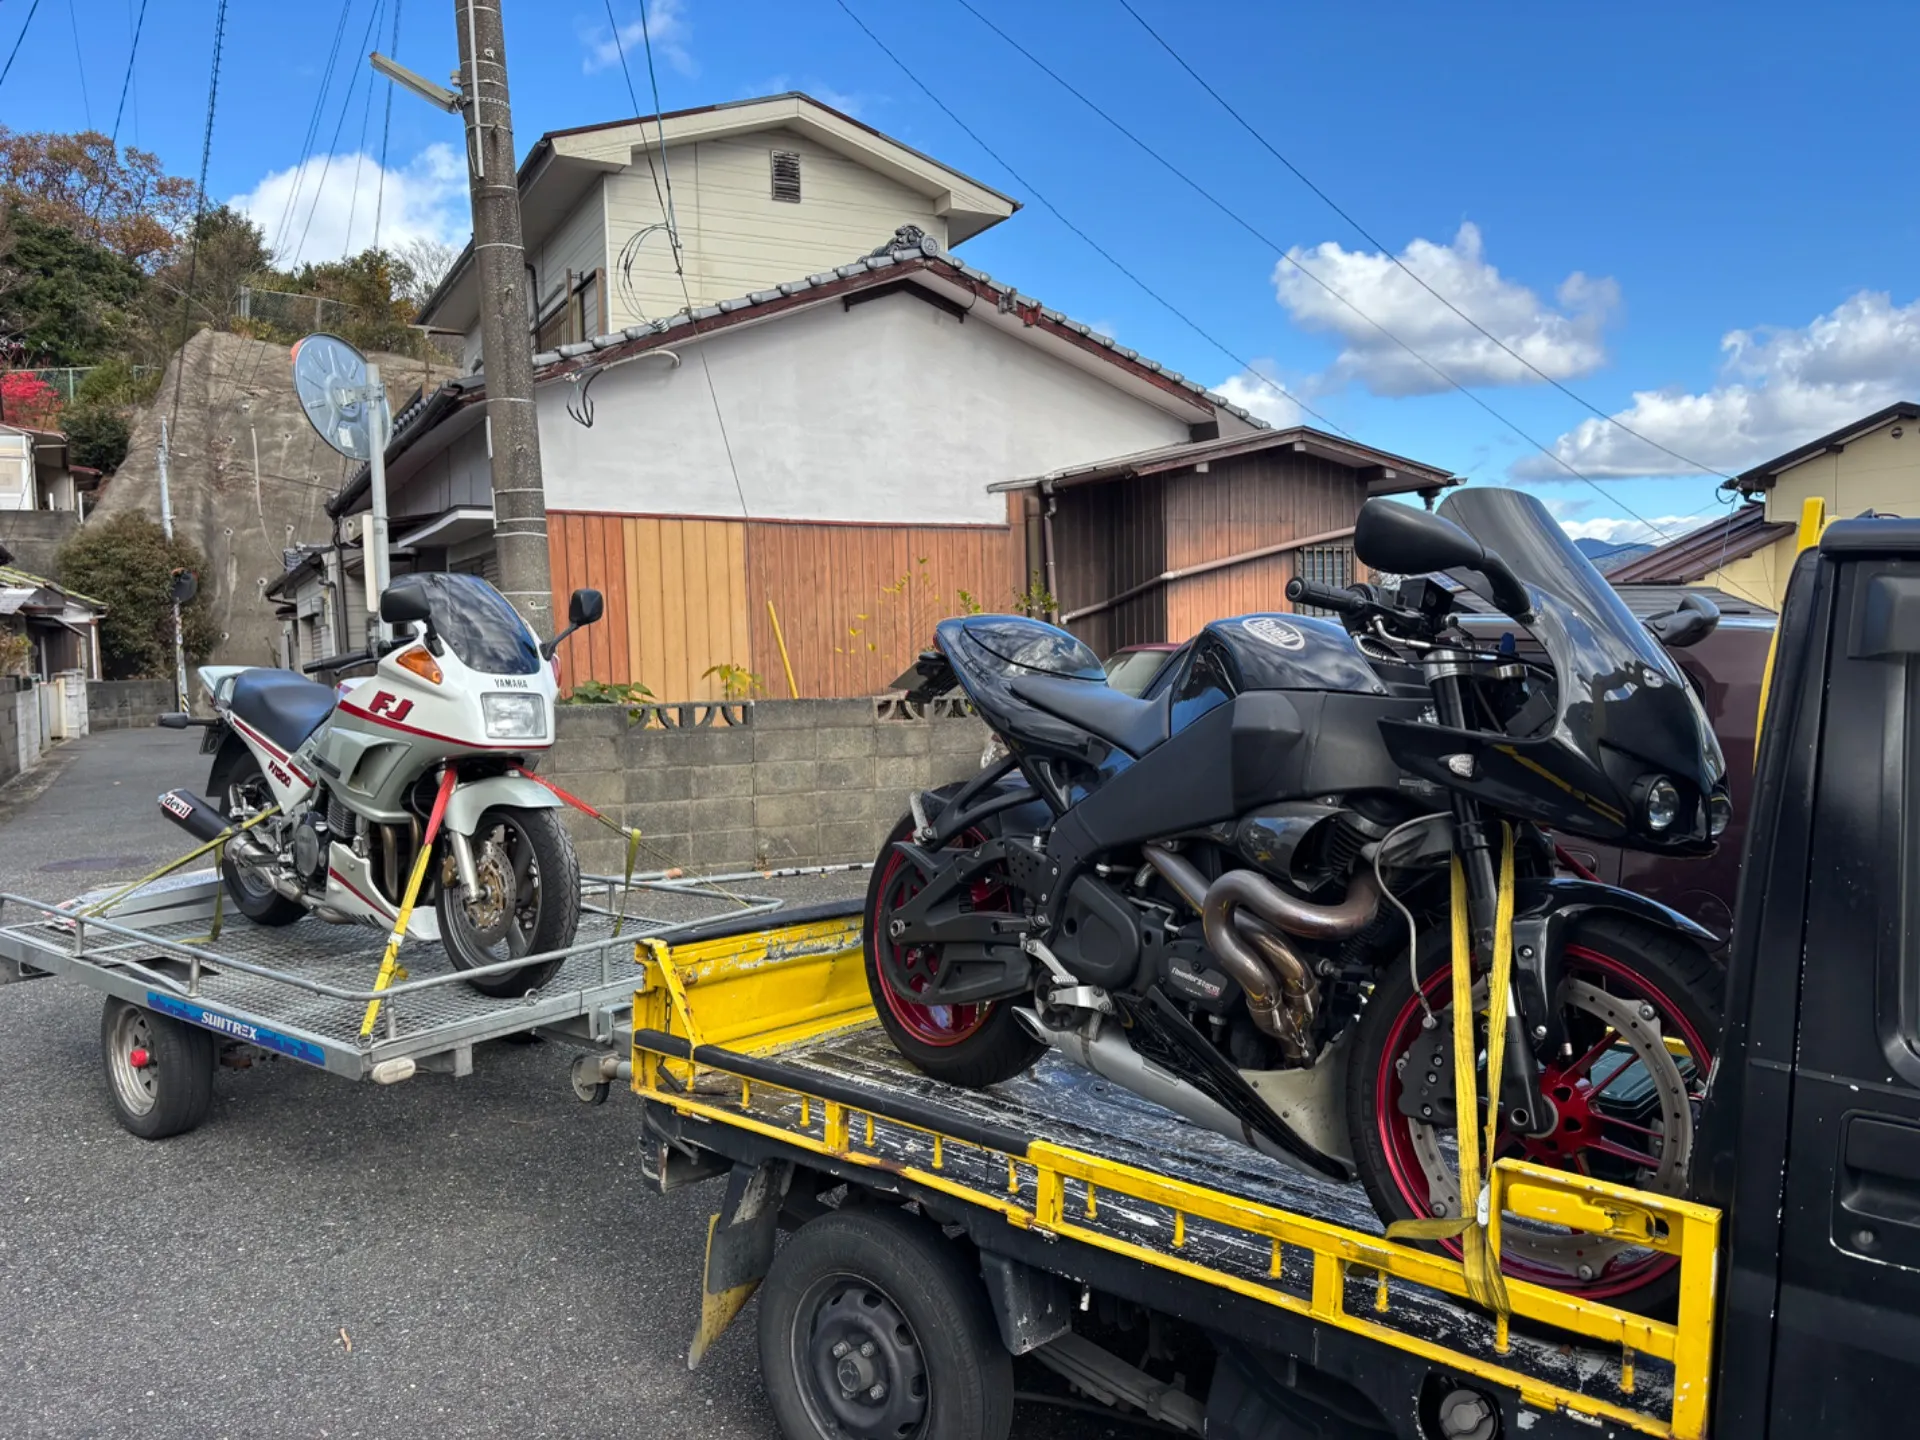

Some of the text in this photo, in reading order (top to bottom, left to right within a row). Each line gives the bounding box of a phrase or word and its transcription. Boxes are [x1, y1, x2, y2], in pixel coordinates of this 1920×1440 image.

[494, 678, 528, 688] YAMAHA
[368, 690, 414, 721] FJ
[165, 797, 190, 817] devil
[201, 1011, 257, 1040] SUNTREX
